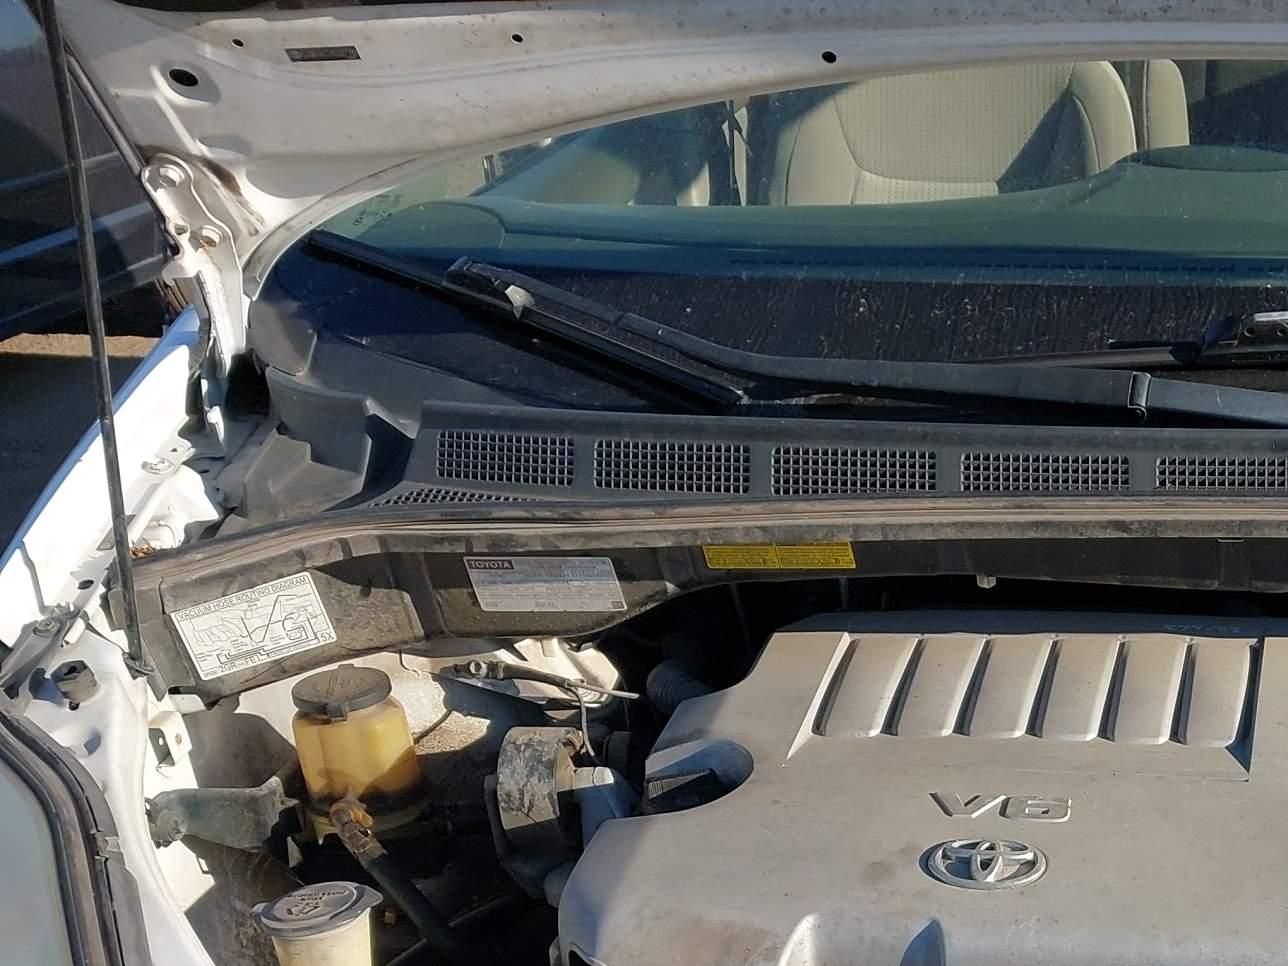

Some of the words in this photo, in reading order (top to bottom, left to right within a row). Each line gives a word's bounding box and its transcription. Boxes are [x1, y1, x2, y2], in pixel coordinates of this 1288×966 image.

[469, 560, 512, 569] TOYOTA
[177, 604, 211, 620] VACUUM
[212, 598, 233, 611] HOSE
[235, 588, 271, 603] ROUTING
[271, 576, 309, 593] DIAGRAM
[928, 791, 1073, 823] V6
